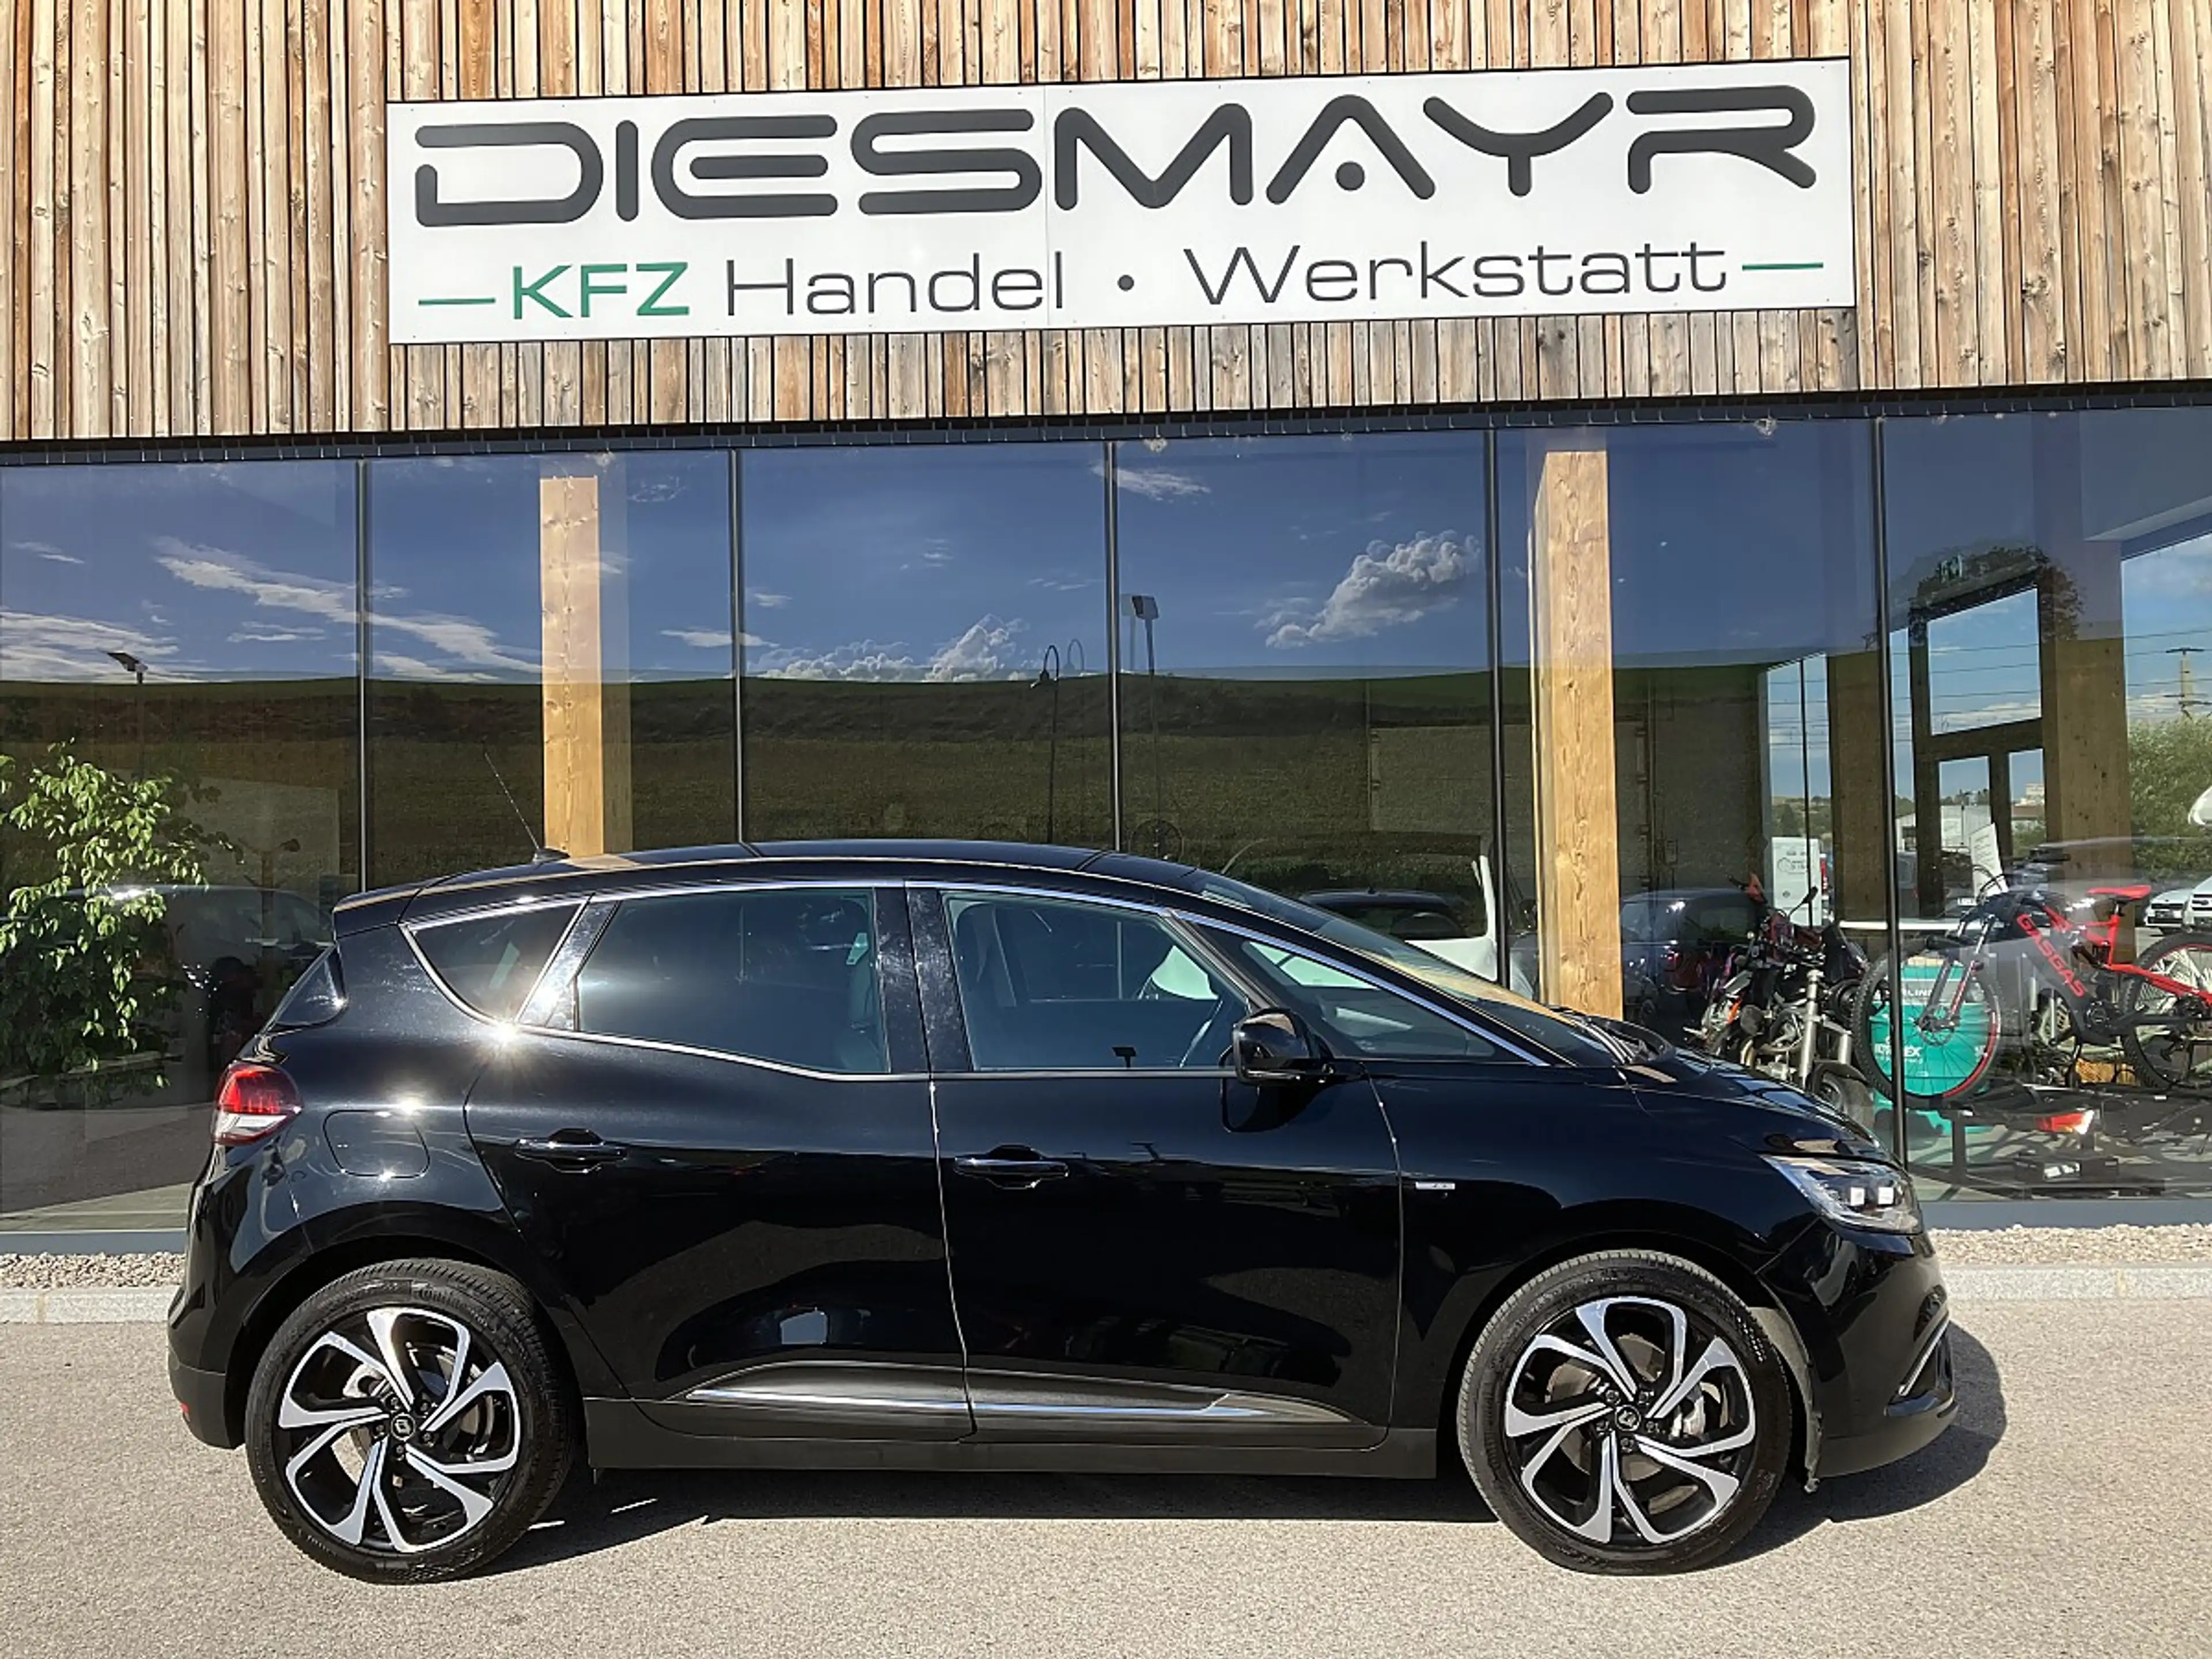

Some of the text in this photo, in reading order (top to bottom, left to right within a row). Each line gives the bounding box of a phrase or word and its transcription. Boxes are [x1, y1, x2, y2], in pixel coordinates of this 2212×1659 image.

[414, 85, 1817, 228] DIESMAYR
[513, 241, 1726, 320] KFZ Handel Werkstatt
[2017, 914, 2086, 997] GASGAS
